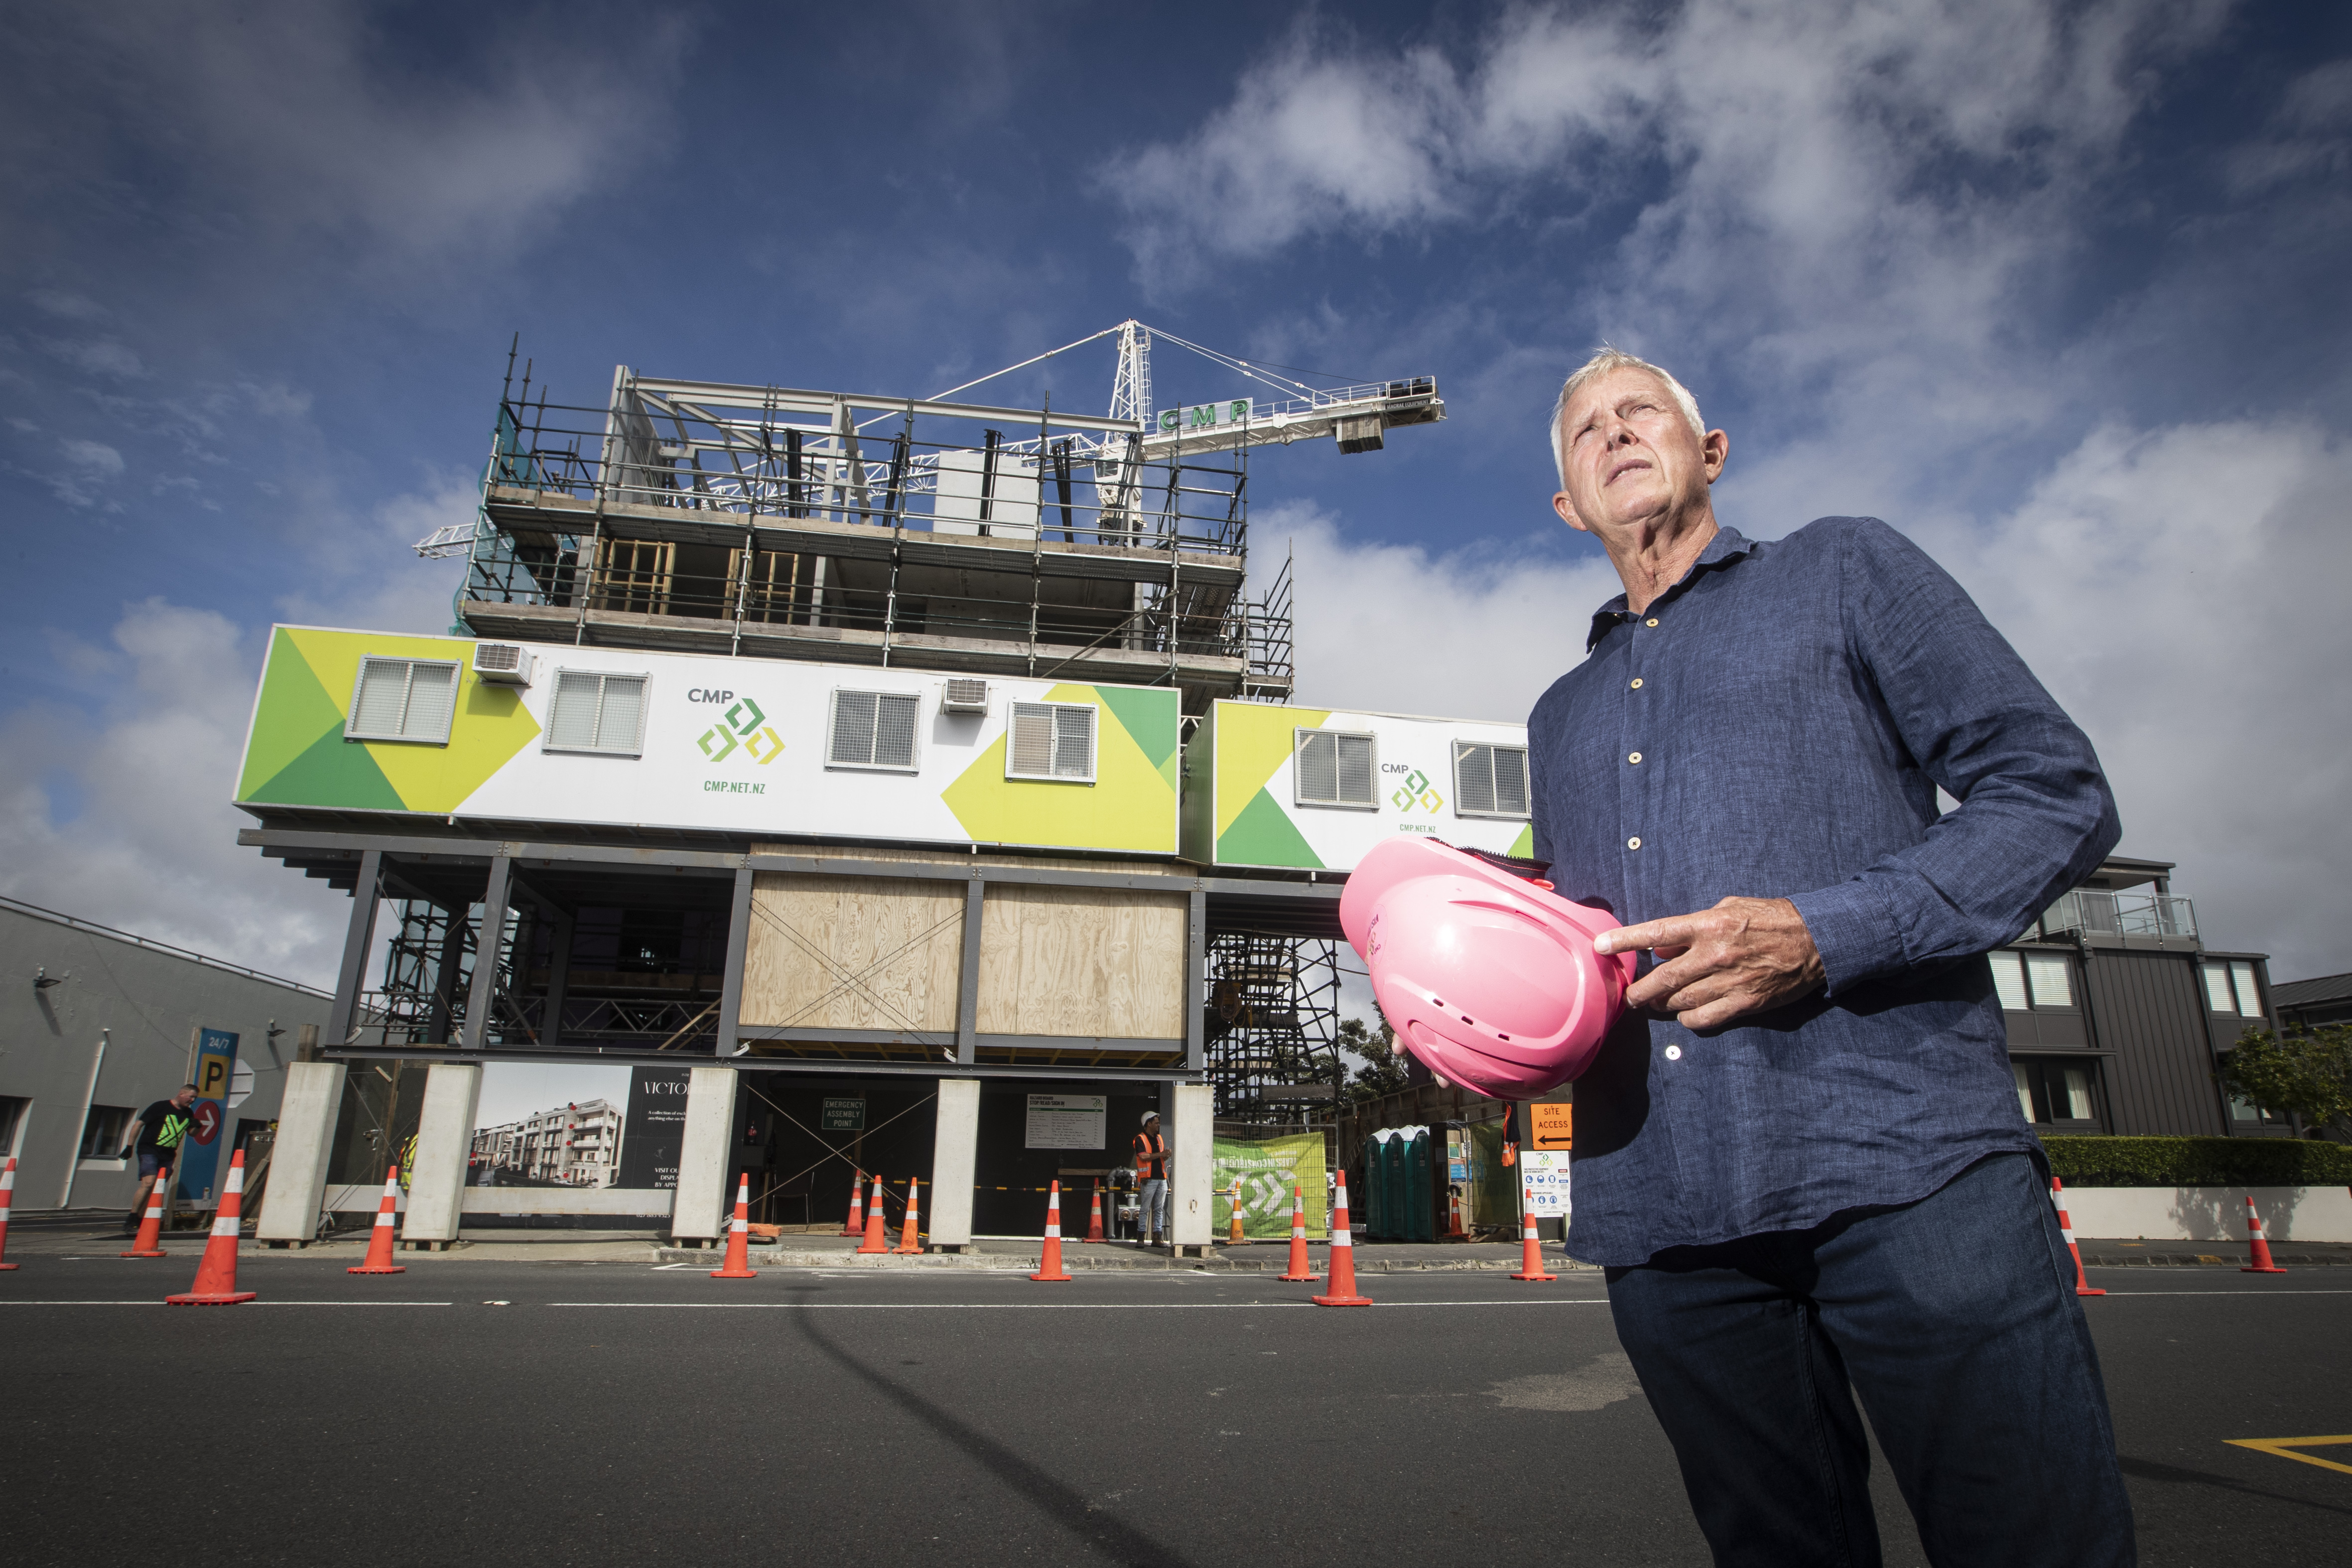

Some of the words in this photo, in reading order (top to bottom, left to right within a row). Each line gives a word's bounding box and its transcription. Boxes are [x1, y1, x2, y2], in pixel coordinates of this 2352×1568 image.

[1161, 400, 1248, 430] CMP
[687, 688, 734, 704] CMP
[1381, 764, 1409, 774] CMP
[704, 781, 766, 794] CMP.NET.NZ
[1400, 824, 1436, 833] CMP.NET.NZ
[209, 1037, 229, 1049] 24/7
[205, 1061, 224, 1091] P
